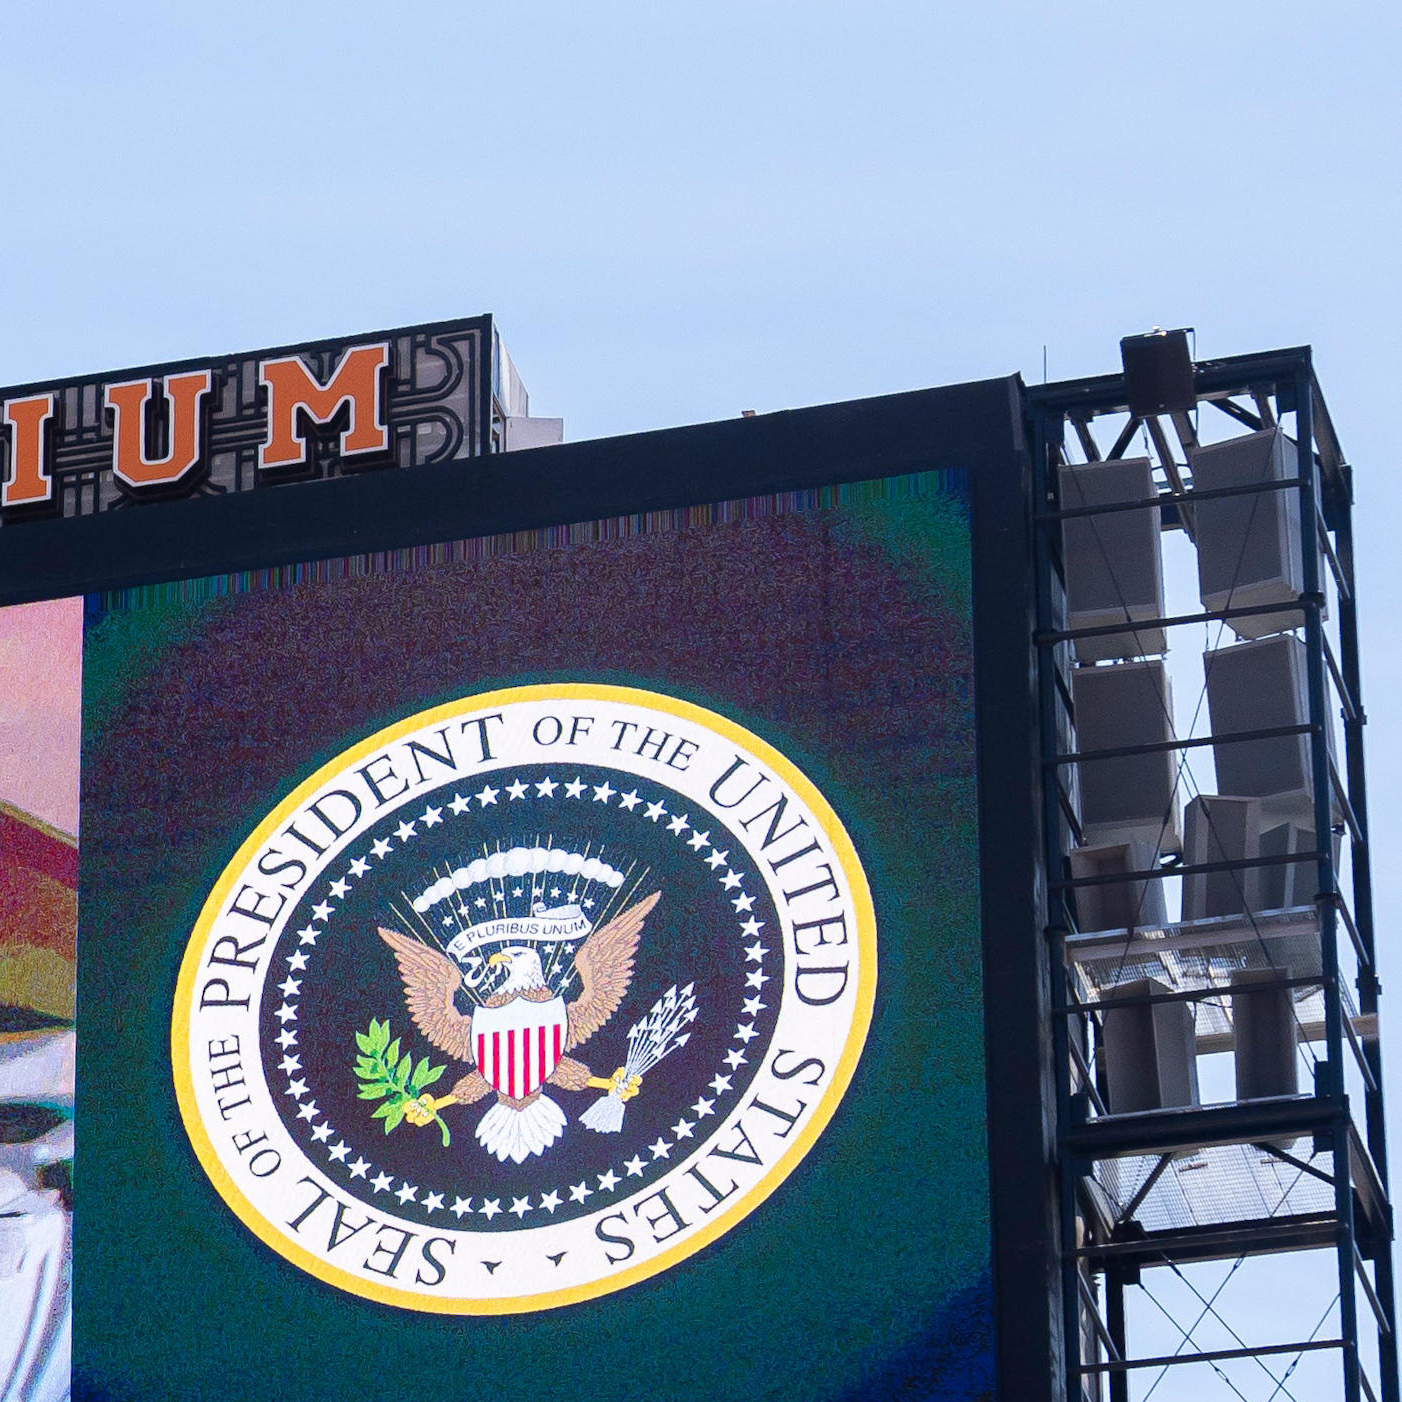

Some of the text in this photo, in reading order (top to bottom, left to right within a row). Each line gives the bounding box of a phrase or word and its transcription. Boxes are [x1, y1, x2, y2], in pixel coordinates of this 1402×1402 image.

[200, 714, 849, 1285] SEAL OF THE PRESIDENT OF THE UNITED STATES
[454, 919, 587, 952] E PLURIBUS UNUM
